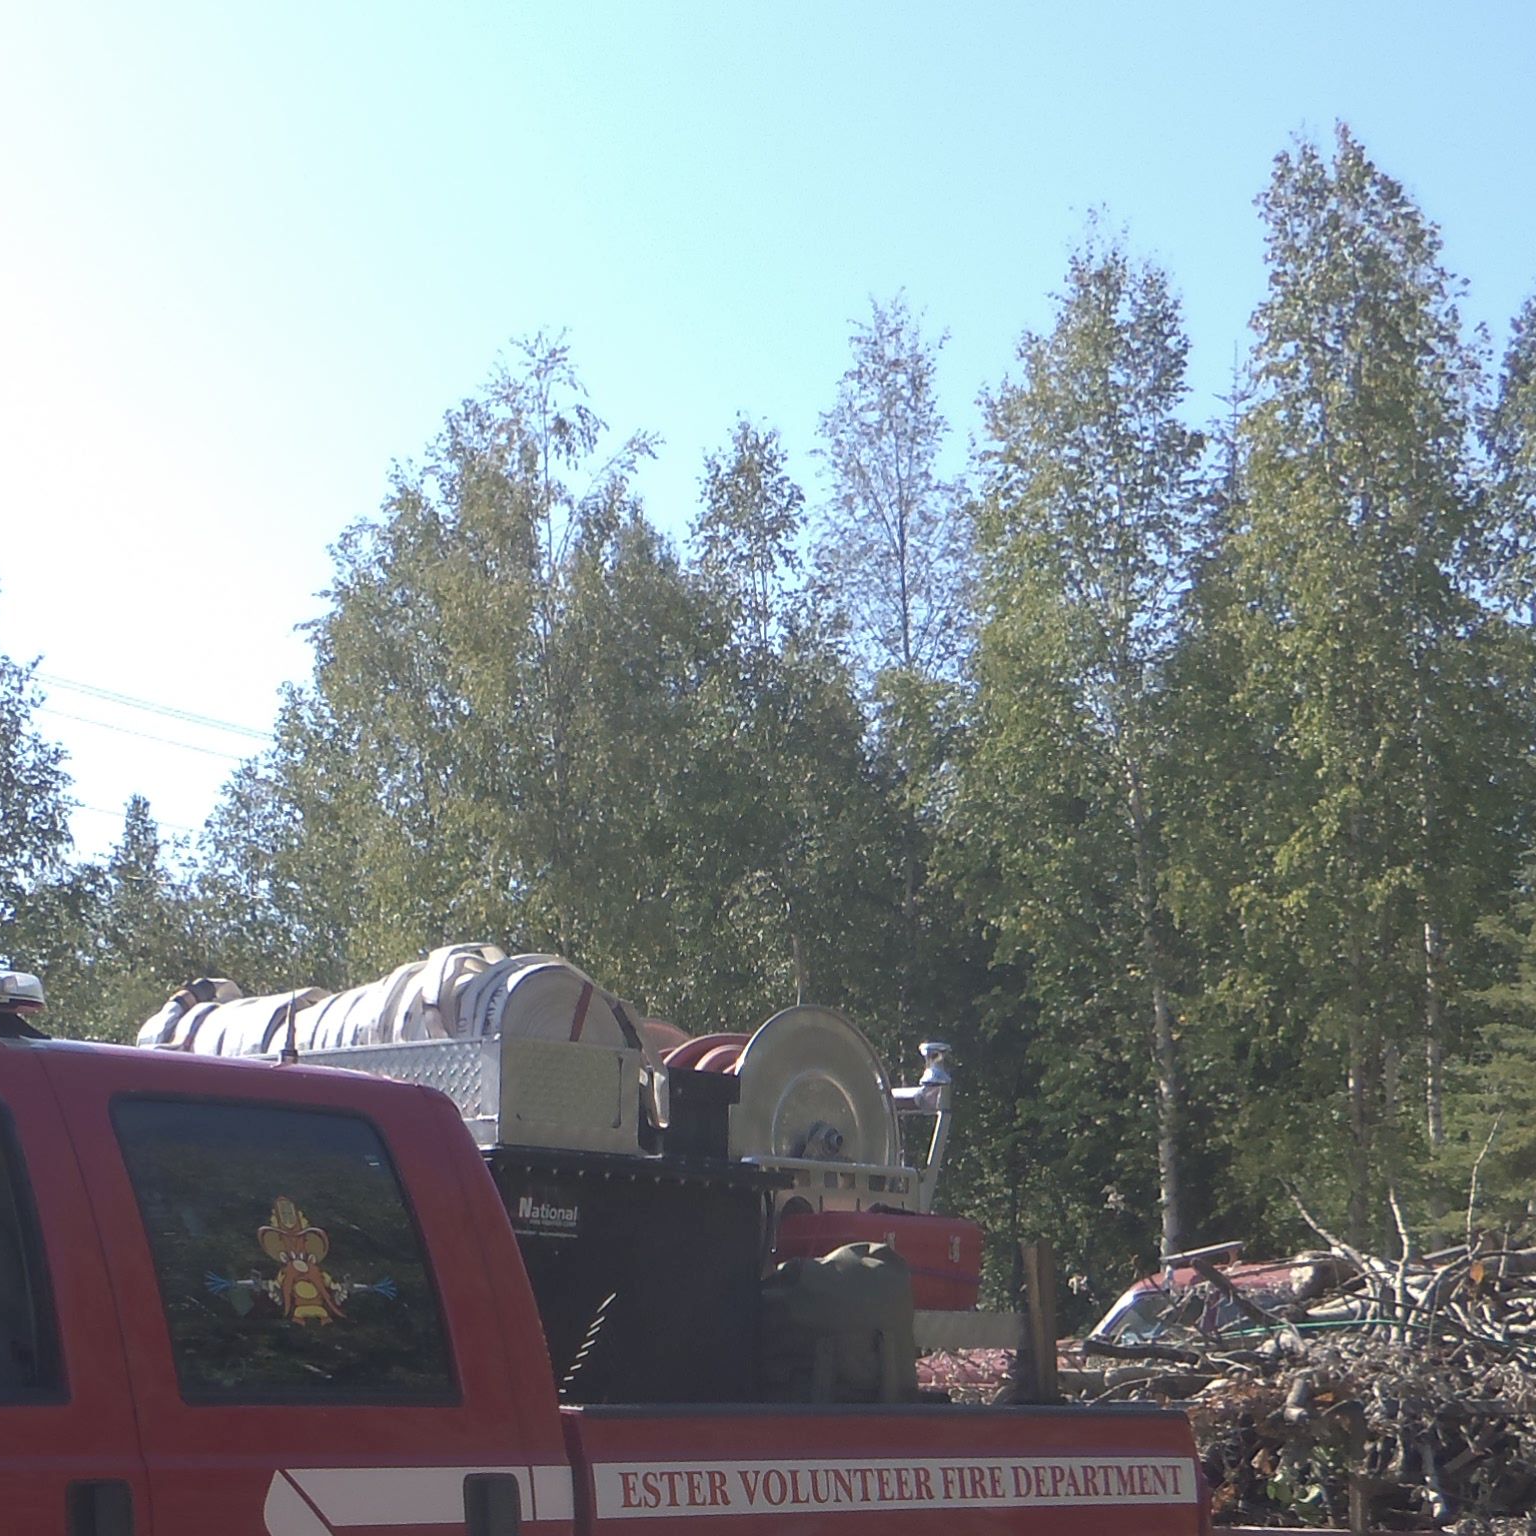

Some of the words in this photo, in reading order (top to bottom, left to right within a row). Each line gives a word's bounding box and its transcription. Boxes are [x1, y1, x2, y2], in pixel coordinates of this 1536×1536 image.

[519, 1196, 578, 1221] National
[618, 1470, 731, 1508] ESTER
[737, 1467, 935, 1506] VOLUNTEER
[939, 1465, 1006, 1500] FIRE
[1011, 1464, 1182, 1498] DEPARTMENT
